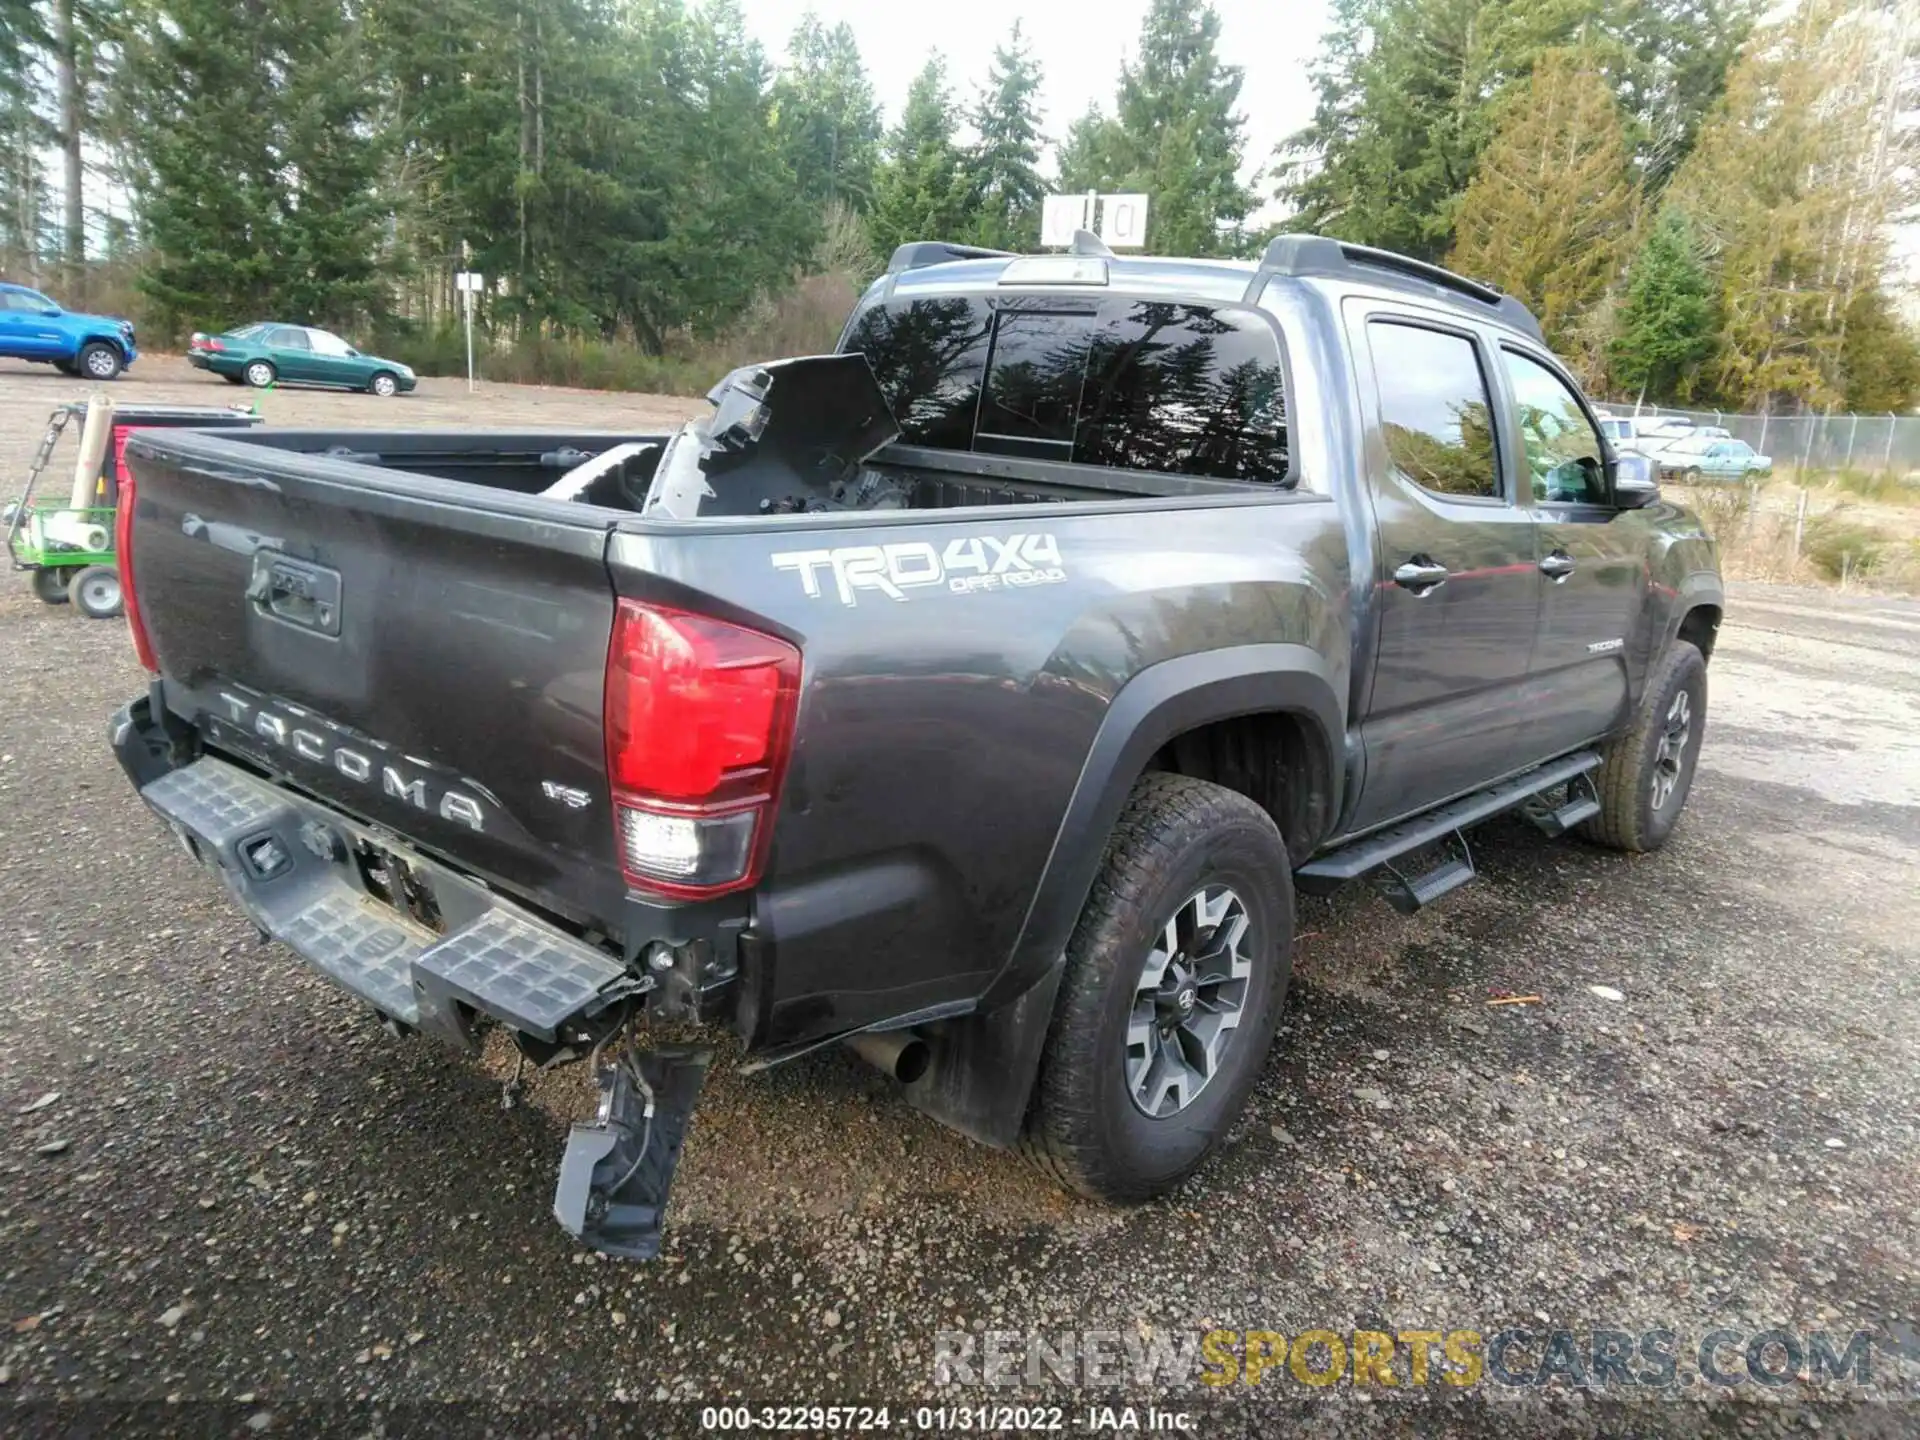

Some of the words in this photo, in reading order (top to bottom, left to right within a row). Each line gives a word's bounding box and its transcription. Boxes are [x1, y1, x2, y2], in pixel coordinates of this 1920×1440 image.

[771, 542, 945, 607] TRD
[949, 573, 1000, 594] OFF
[1002, 568, 1067, 590] ROAD
[219, 692, 485, 832] TACOMA
